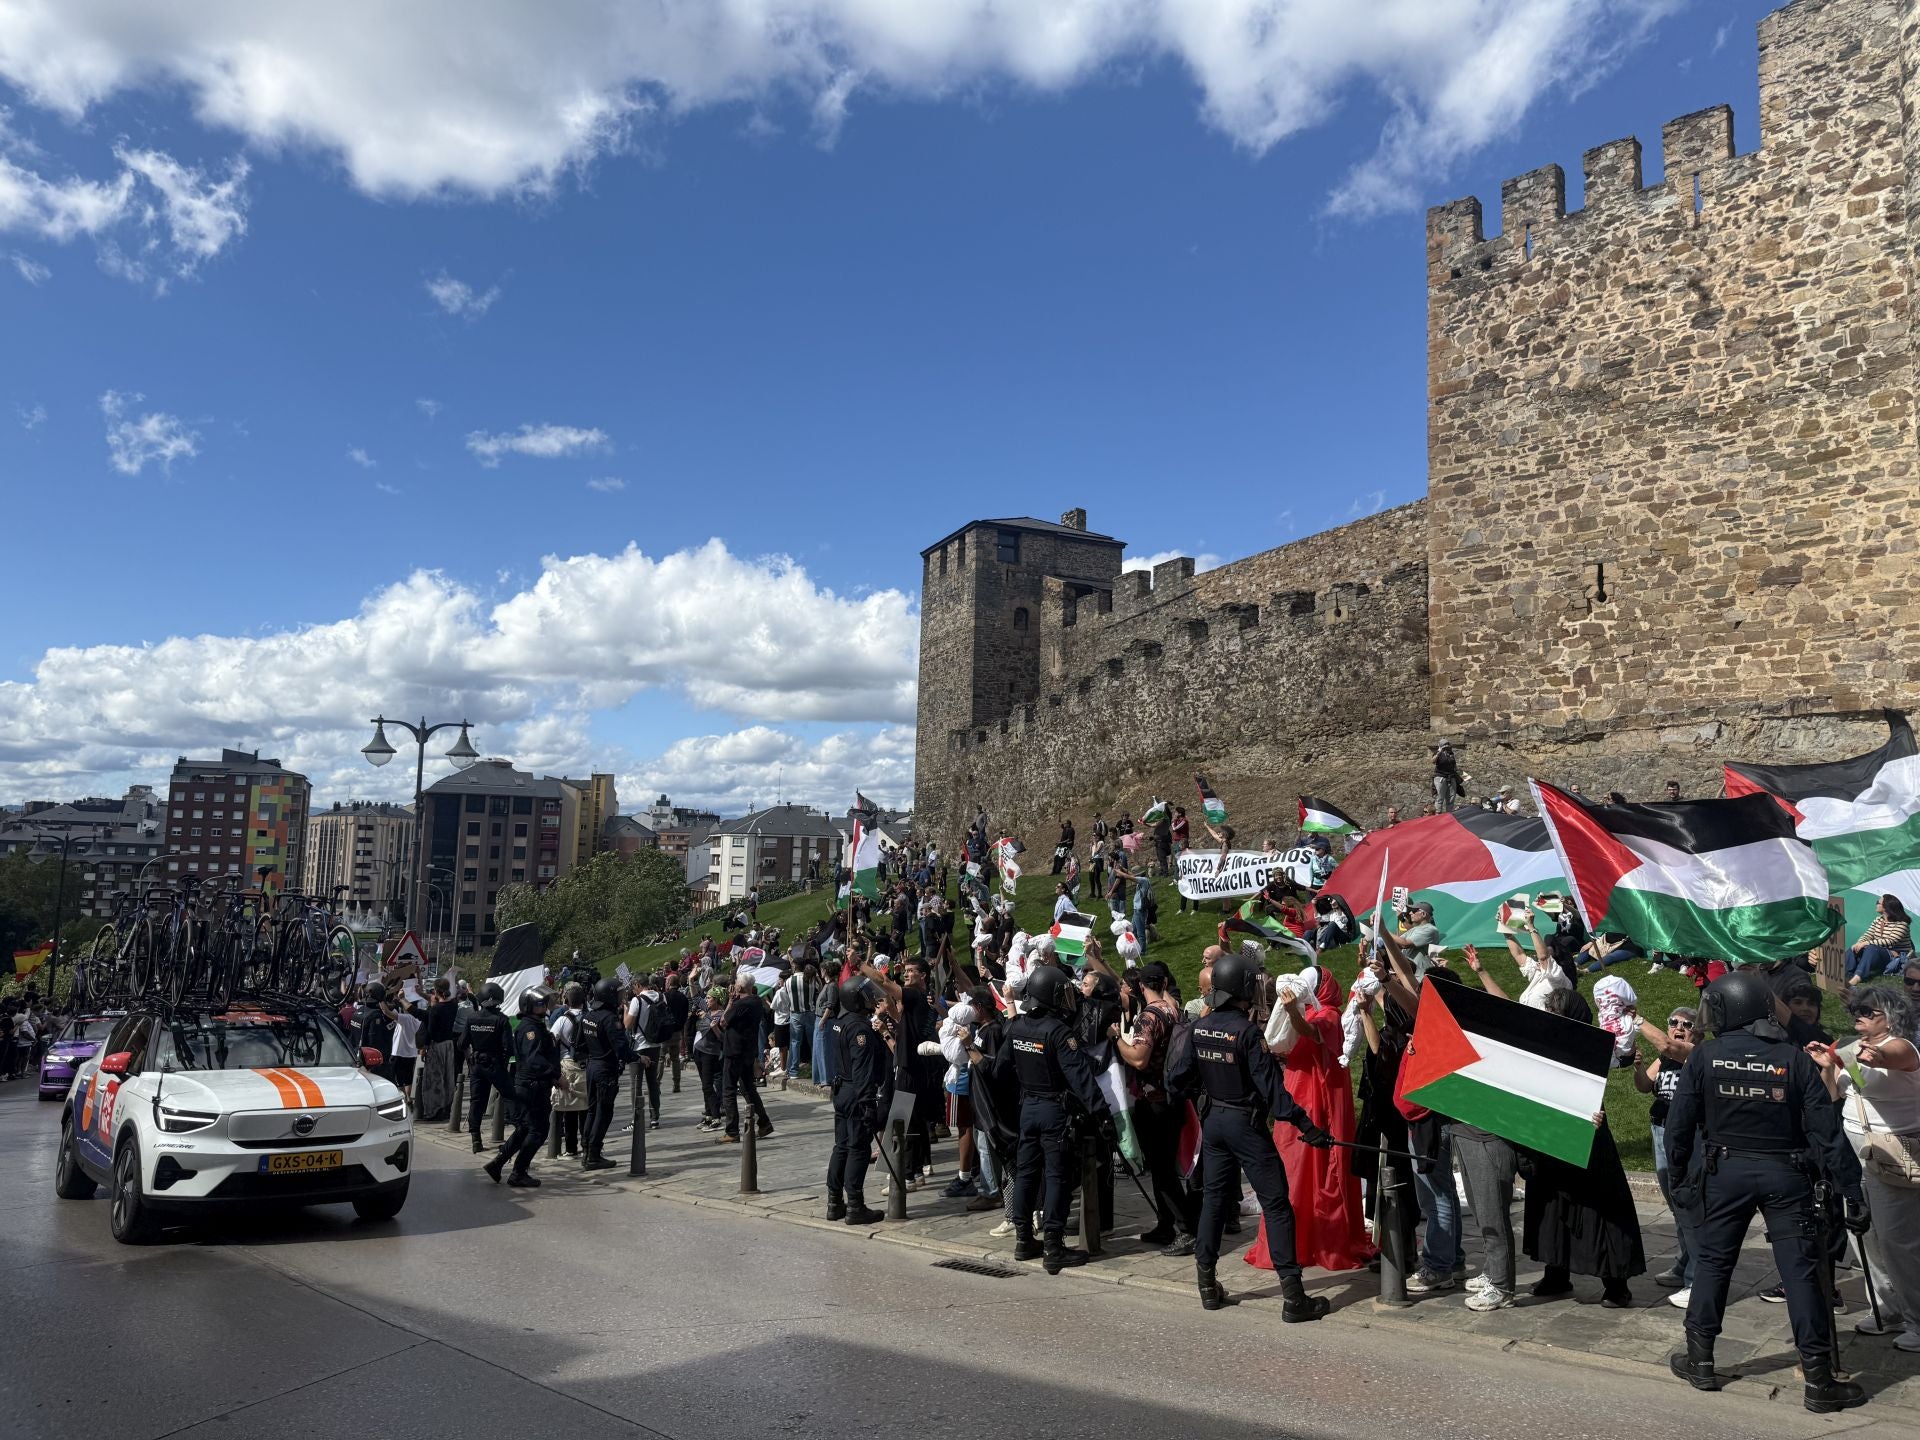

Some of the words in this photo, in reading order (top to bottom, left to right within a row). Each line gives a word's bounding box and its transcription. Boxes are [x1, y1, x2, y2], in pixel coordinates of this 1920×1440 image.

[1188, 871, 1253, 895] TOLERANCIA
[1255, 866, 1296, 887] CEO
[1194, 1028, 1229, 1039] POLICIA
[1012, 1039, 1037, 1047] POLICIA
[1013, 1044, 1044, 1054] NACIONAL
[1197, 1049, 1225, 1062] U.I.P.
[1712, 1060, 1776, 1073] POLICIA
[1719, 1084, 1770, 1099] U.I.P.
[273, 1152, 337, 1169] GXS-04-K
